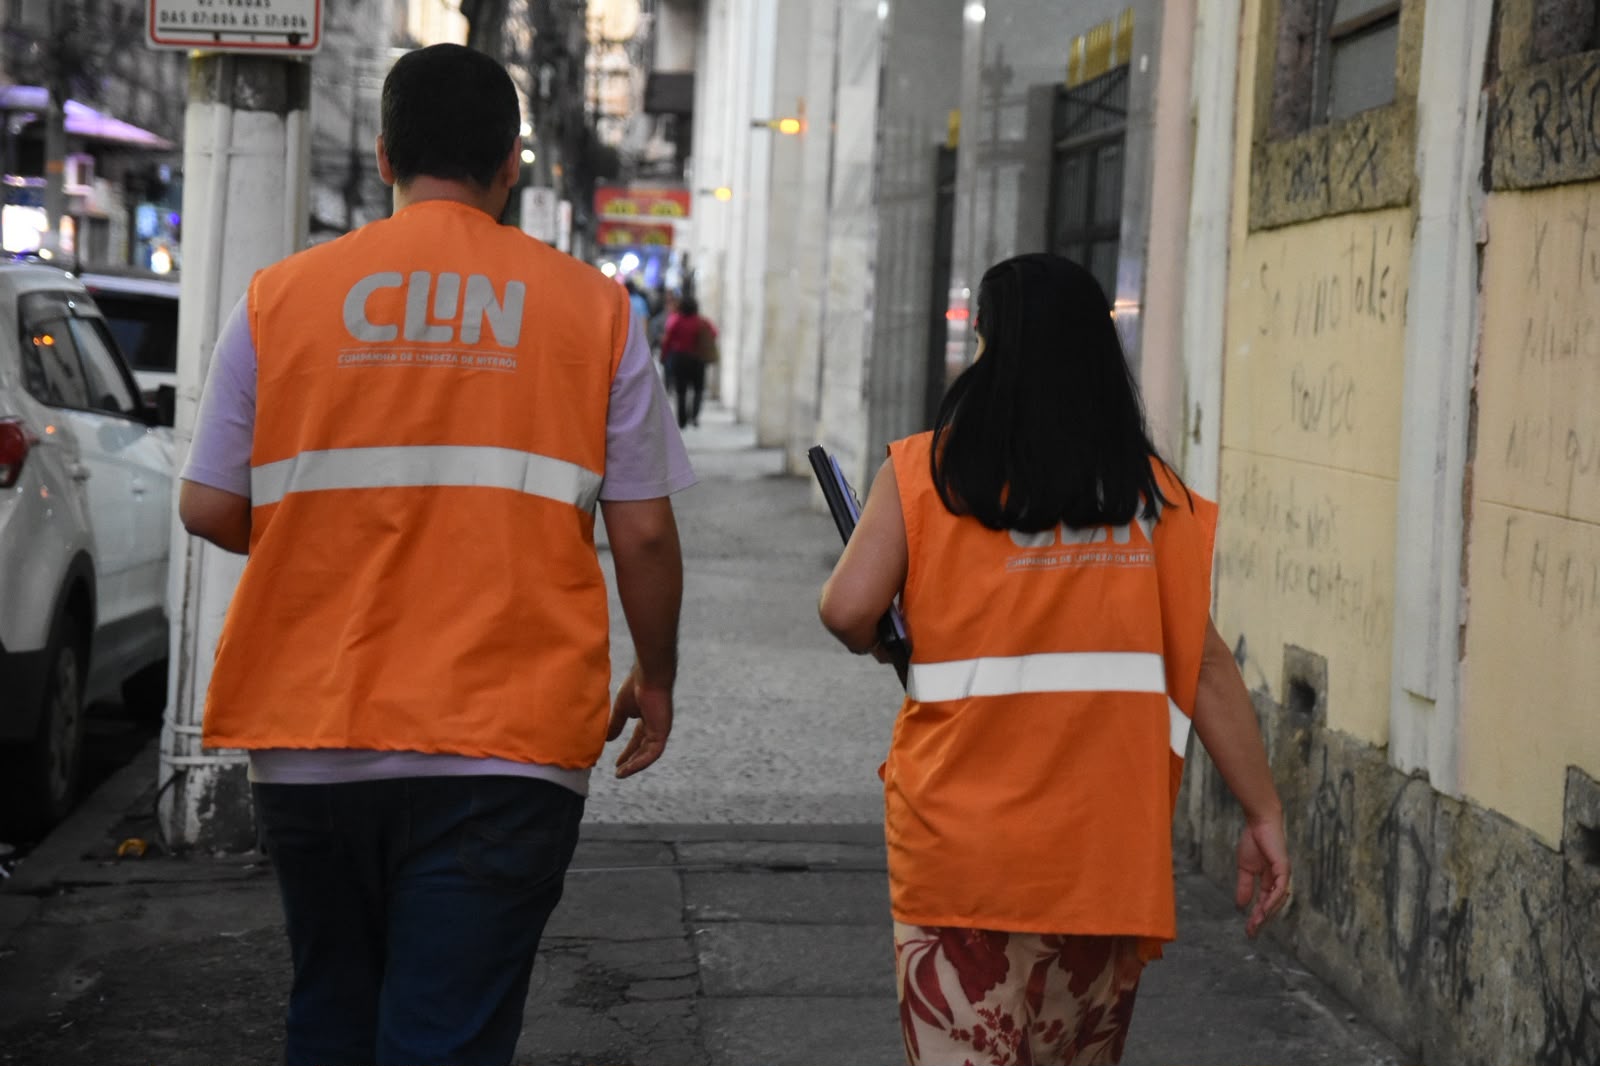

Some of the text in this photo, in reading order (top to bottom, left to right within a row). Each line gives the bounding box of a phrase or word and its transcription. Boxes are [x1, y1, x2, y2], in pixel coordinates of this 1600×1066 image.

[160, 10, 187, 24] DAS
[343, 271, 526, 348] CLIN
[338, 353, 397, 364] COMPANHIA
[400, 353, 413, 362] DE
[416, 353, 458, 363] LIMPEZA
[461, 355, 473, 365] DE
[1060, 555, 1072, 564] DE
[1115, 554, 1126, 563] DE
